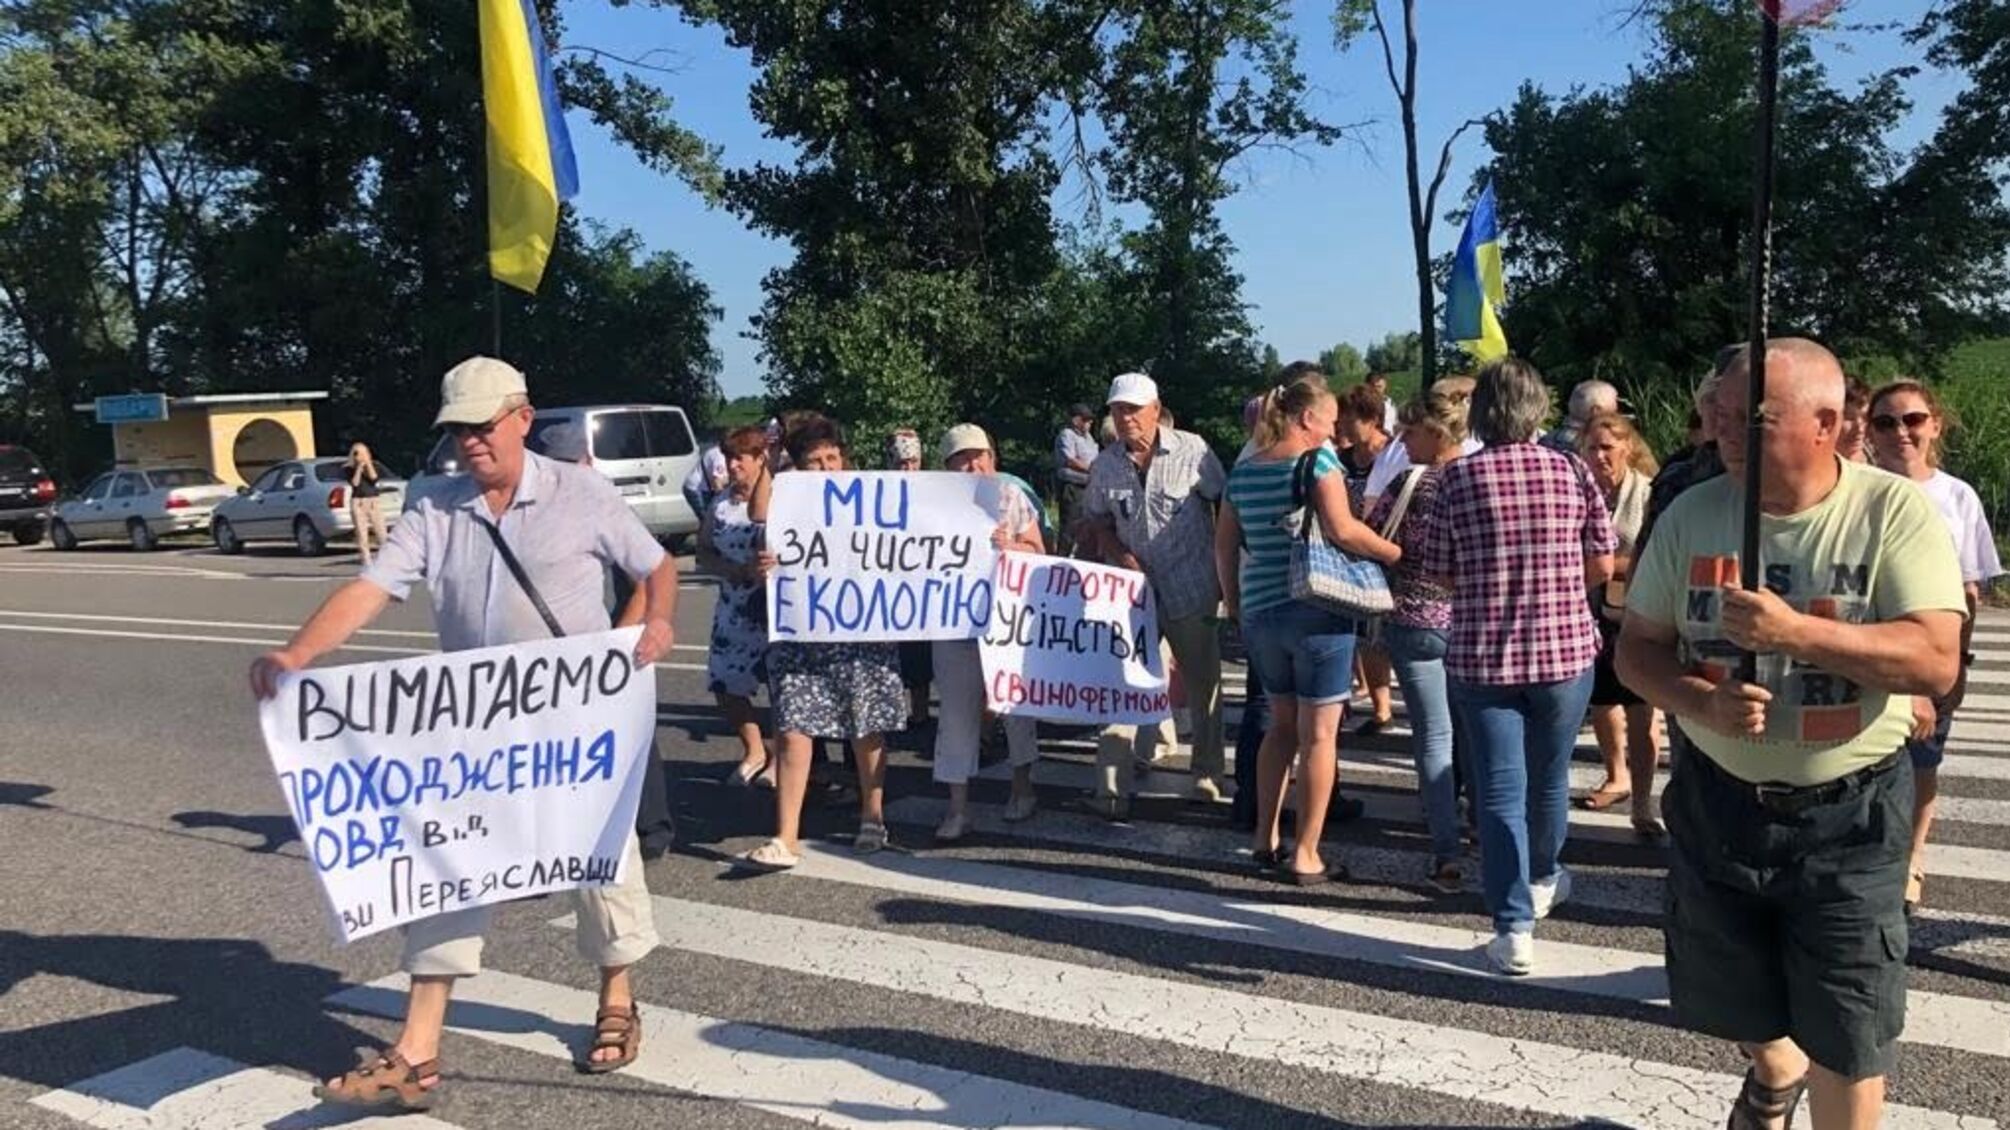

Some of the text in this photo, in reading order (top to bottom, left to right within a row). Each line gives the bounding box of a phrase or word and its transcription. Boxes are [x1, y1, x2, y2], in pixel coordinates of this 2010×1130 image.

[824, 478, 909, 529] МИ
[776, 528, 972, 573] ЗА ЧИСТУ
[1045, 565, 1147, 611] ПРОТИ
[984, 599, 1149, 667] УСІДСТВА
[299, 648, 632, 741] ВИМАГАЄМО
[993, 669, 1168, 715] СВИНОФЕРМОЮ
[314, 815, 405, 872] ОВД
